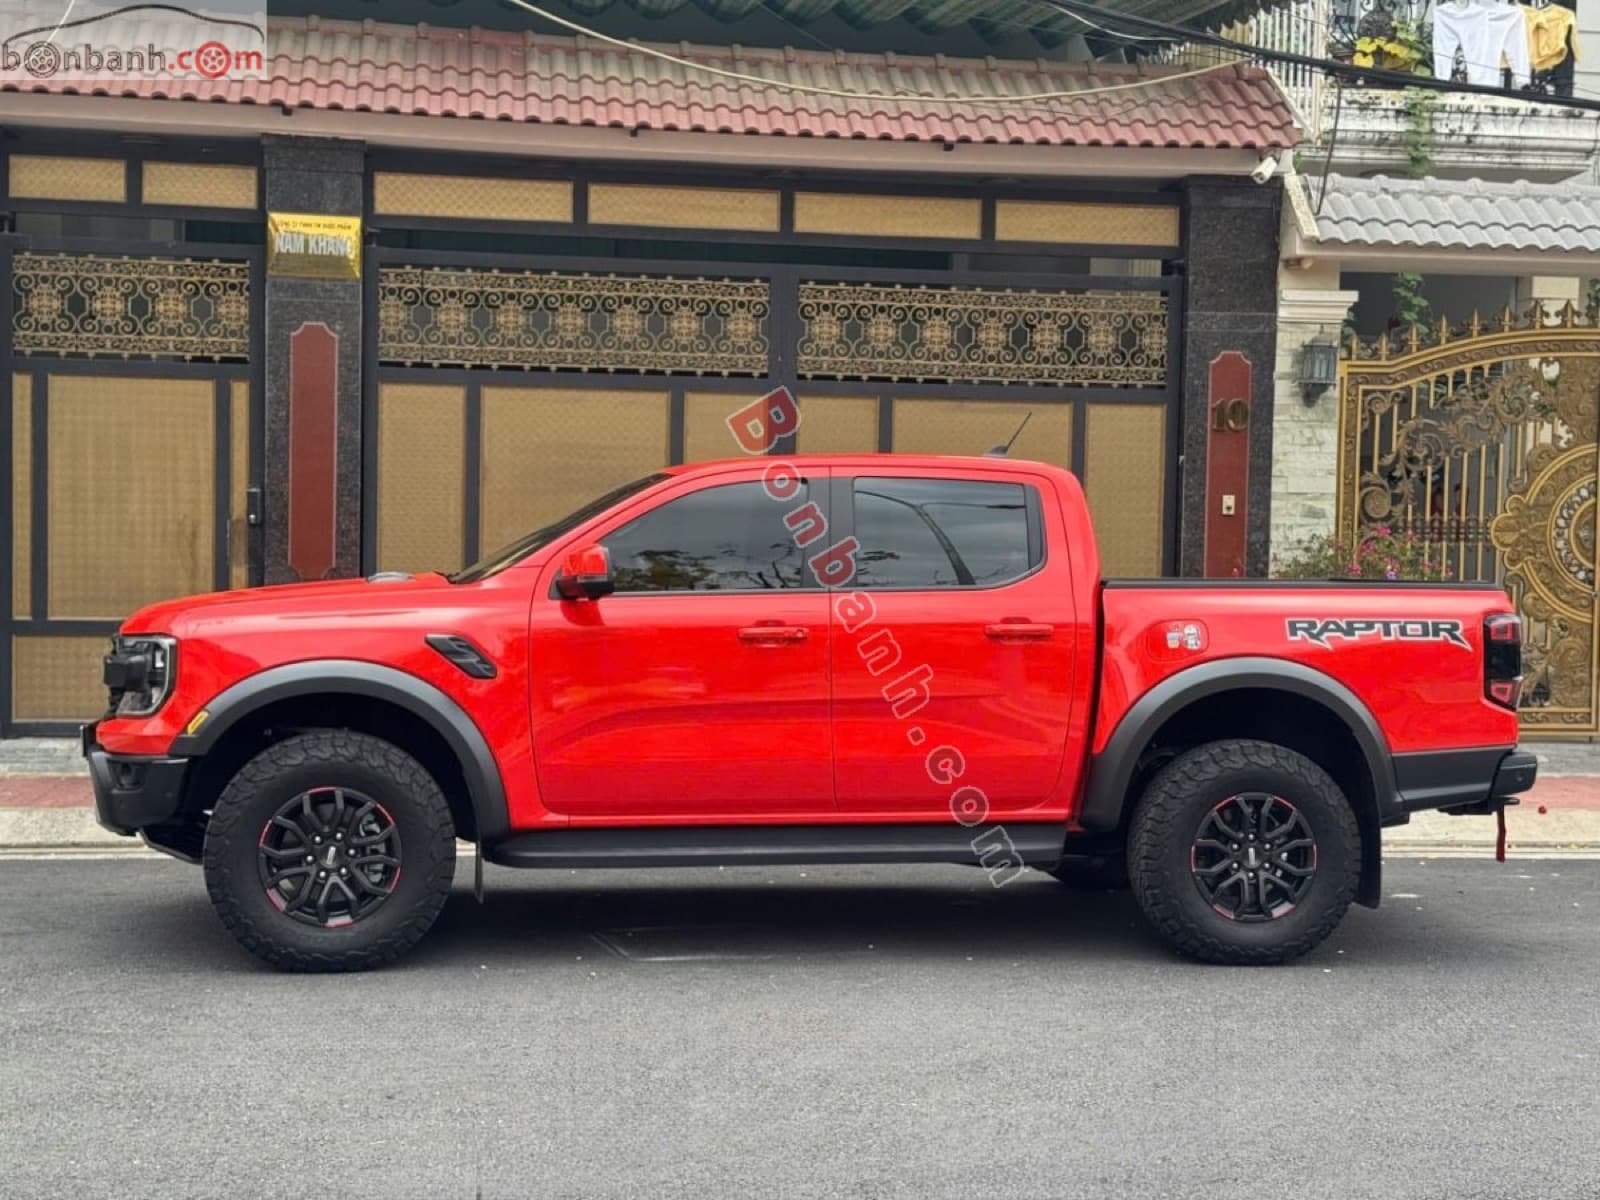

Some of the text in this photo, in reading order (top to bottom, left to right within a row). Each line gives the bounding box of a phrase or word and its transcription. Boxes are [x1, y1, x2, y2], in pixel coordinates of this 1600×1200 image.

[275, 231, 305, 254] NAM
[1211, 397, 1249, 432] 10
[1286, 618, 1473, 651] RAPTOR
